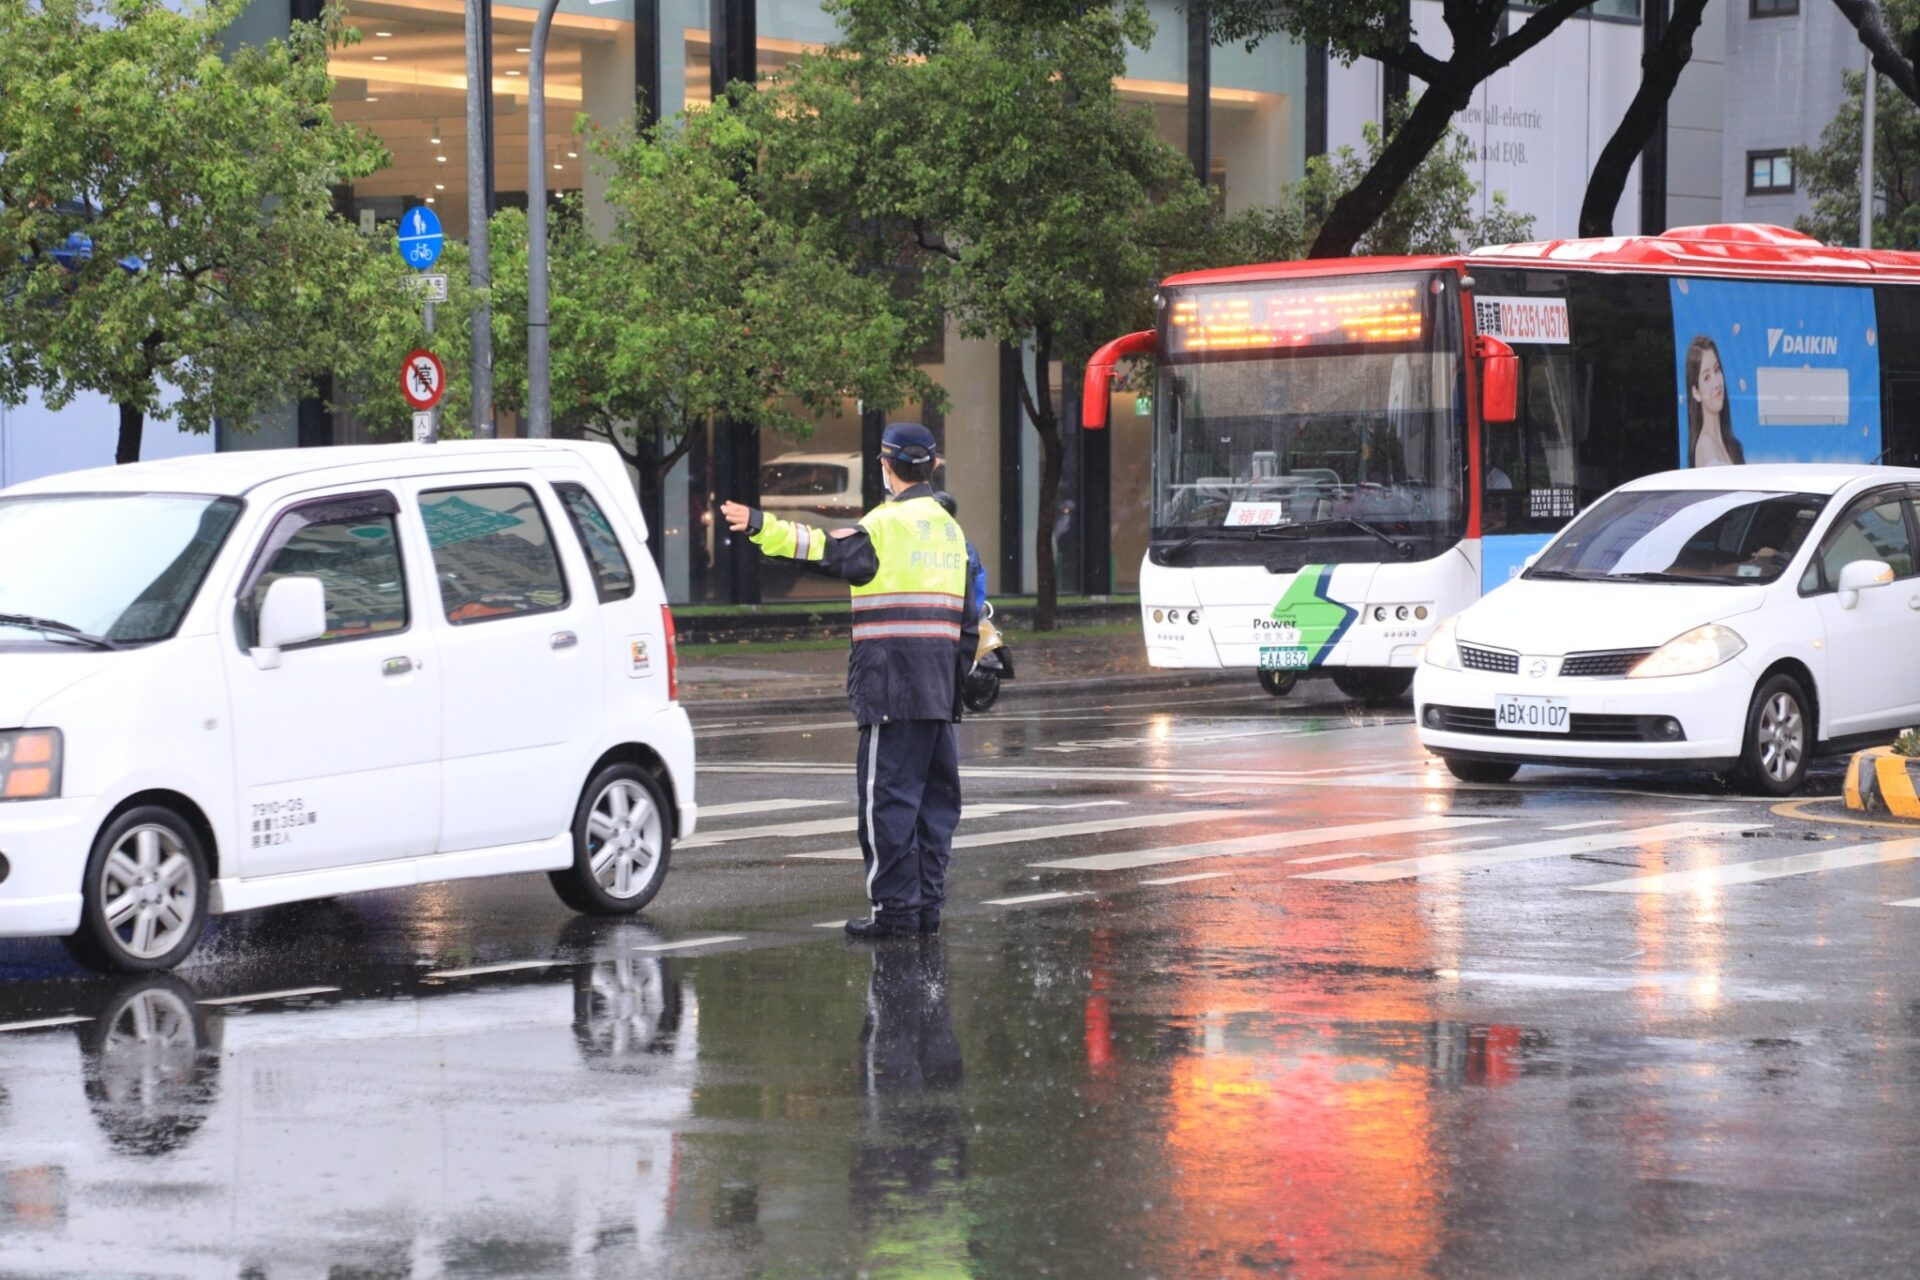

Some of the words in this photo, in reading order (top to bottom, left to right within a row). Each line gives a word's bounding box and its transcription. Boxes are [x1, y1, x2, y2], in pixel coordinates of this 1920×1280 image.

[1501, 303, 1569, 338] 02-2351-0578
[1782, 335, 1838, 355] DAIKIN
[911, 551, 961, 569] POLICE
[1253, 618, 1296, 629] Power
